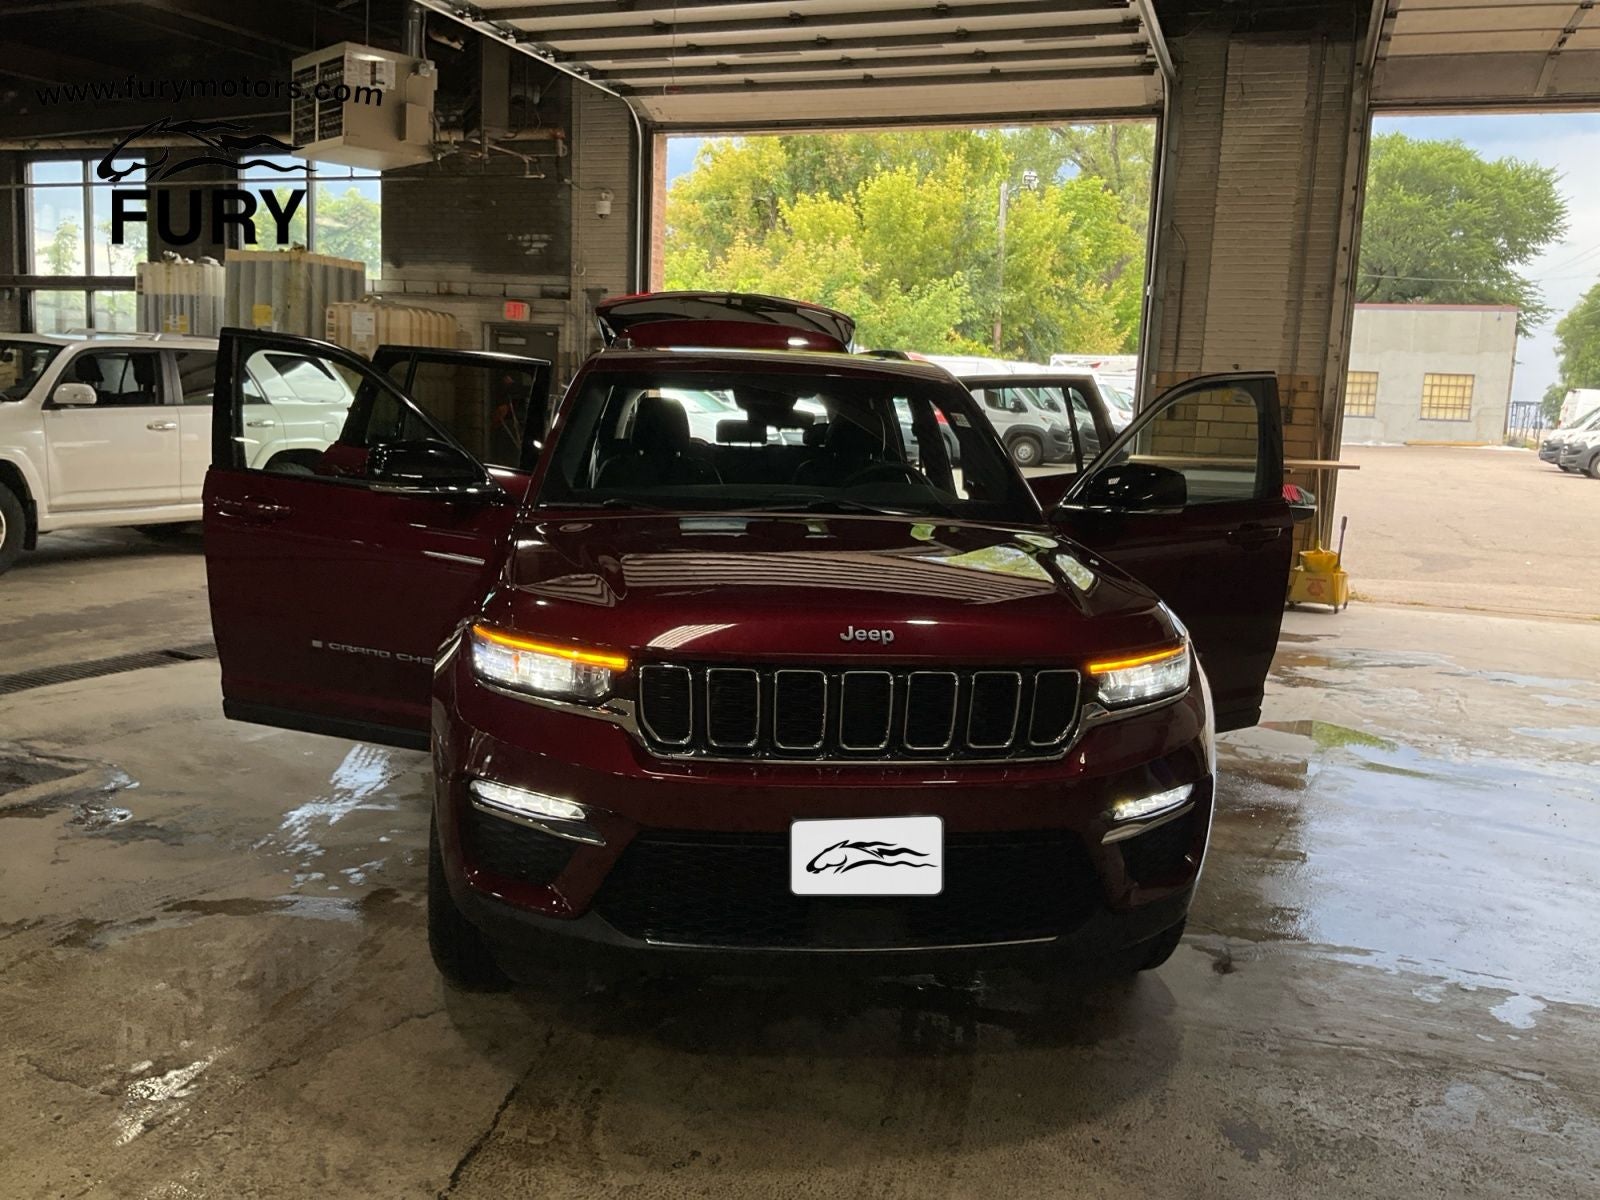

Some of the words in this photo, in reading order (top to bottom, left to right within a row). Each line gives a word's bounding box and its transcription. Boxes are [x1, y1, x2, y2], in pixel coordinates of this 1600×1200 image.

[840, 625, 895, 645] Jeep
[328, 642, 391, 658] GRAND
[396, 653, 436, 665] CHE
